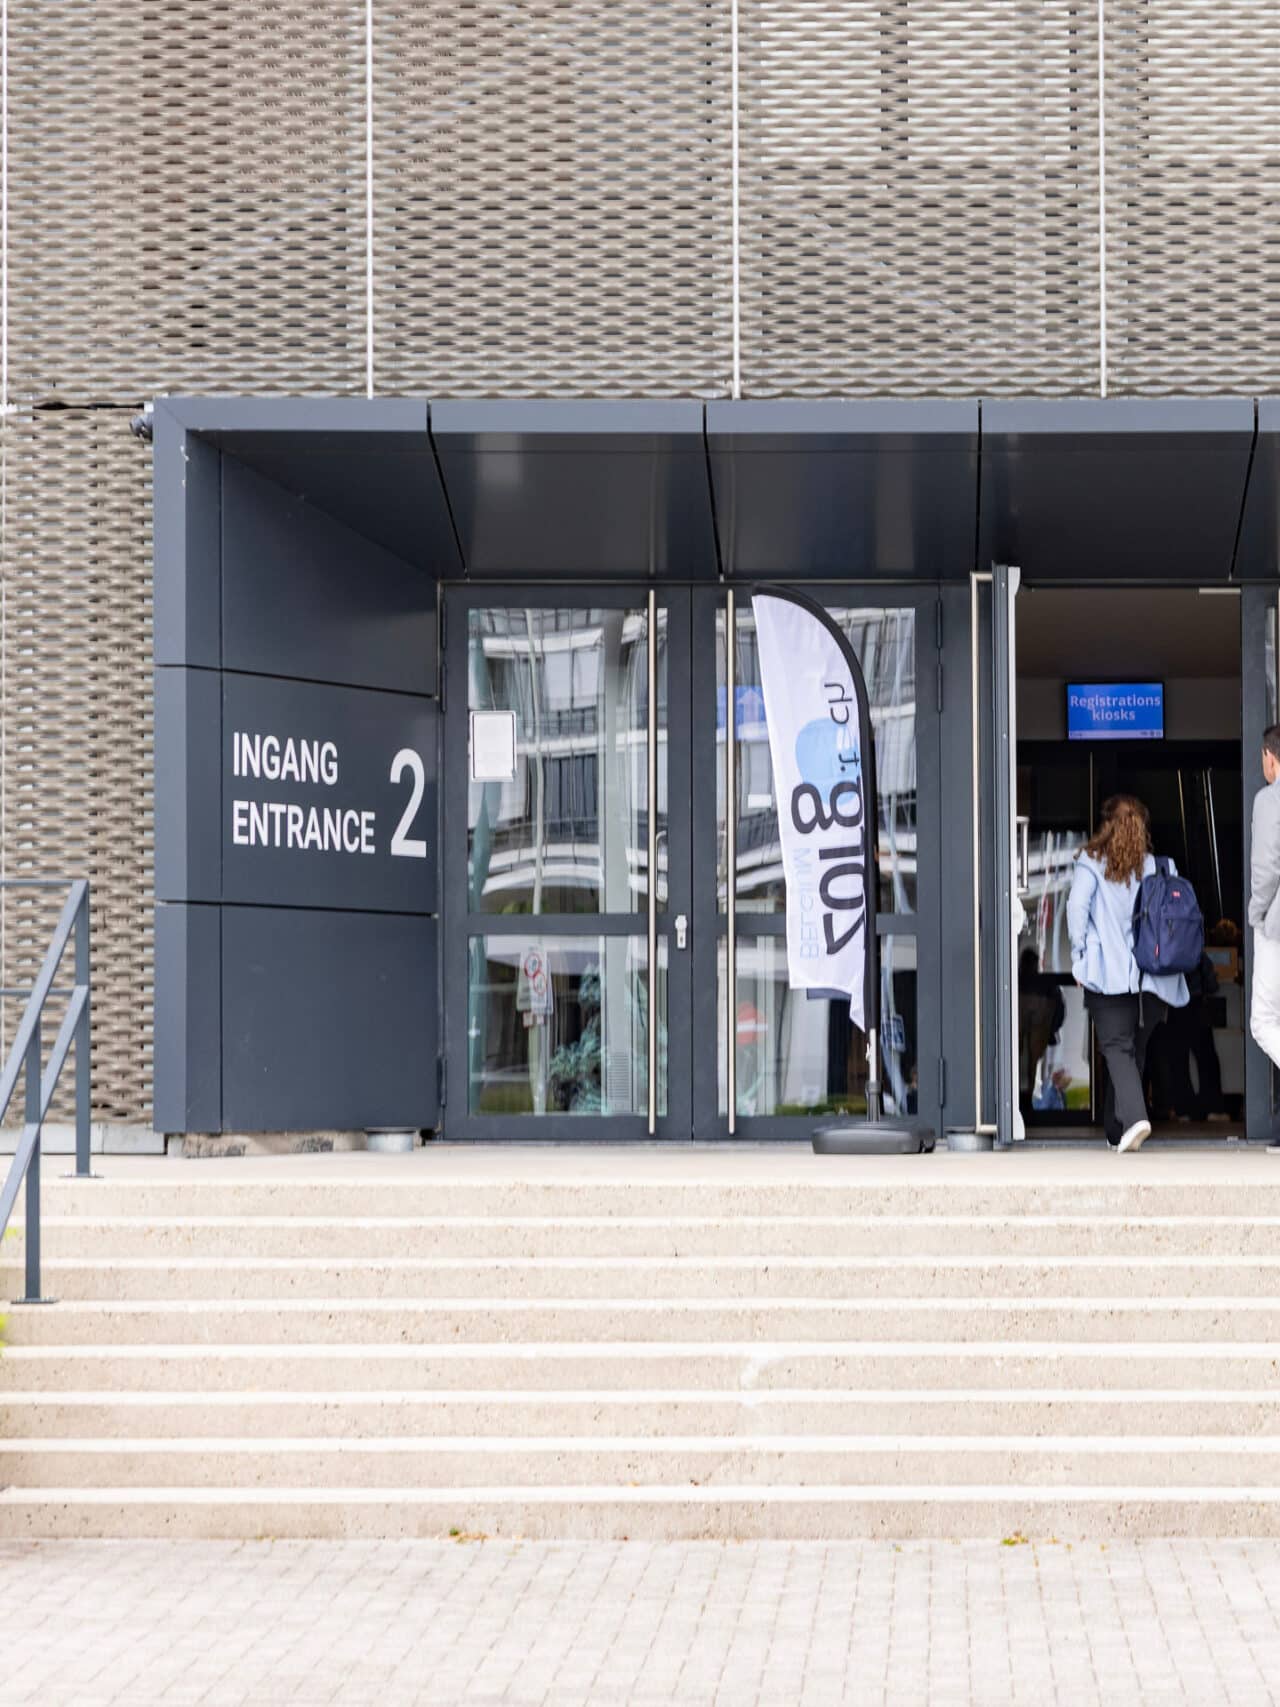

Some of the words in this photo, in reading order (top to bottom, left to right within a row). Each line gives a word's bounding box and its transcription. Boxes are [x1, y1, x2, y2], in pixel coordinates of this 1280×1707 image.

[1070, 694, 1160, 711] Registrations
[1092, 708, 1135, 720] kiosks
[233, 732, 338, 785] INGANG
[233, 800, 376, 854] ENTRANCE
[390, 748, 427, 858] 2
